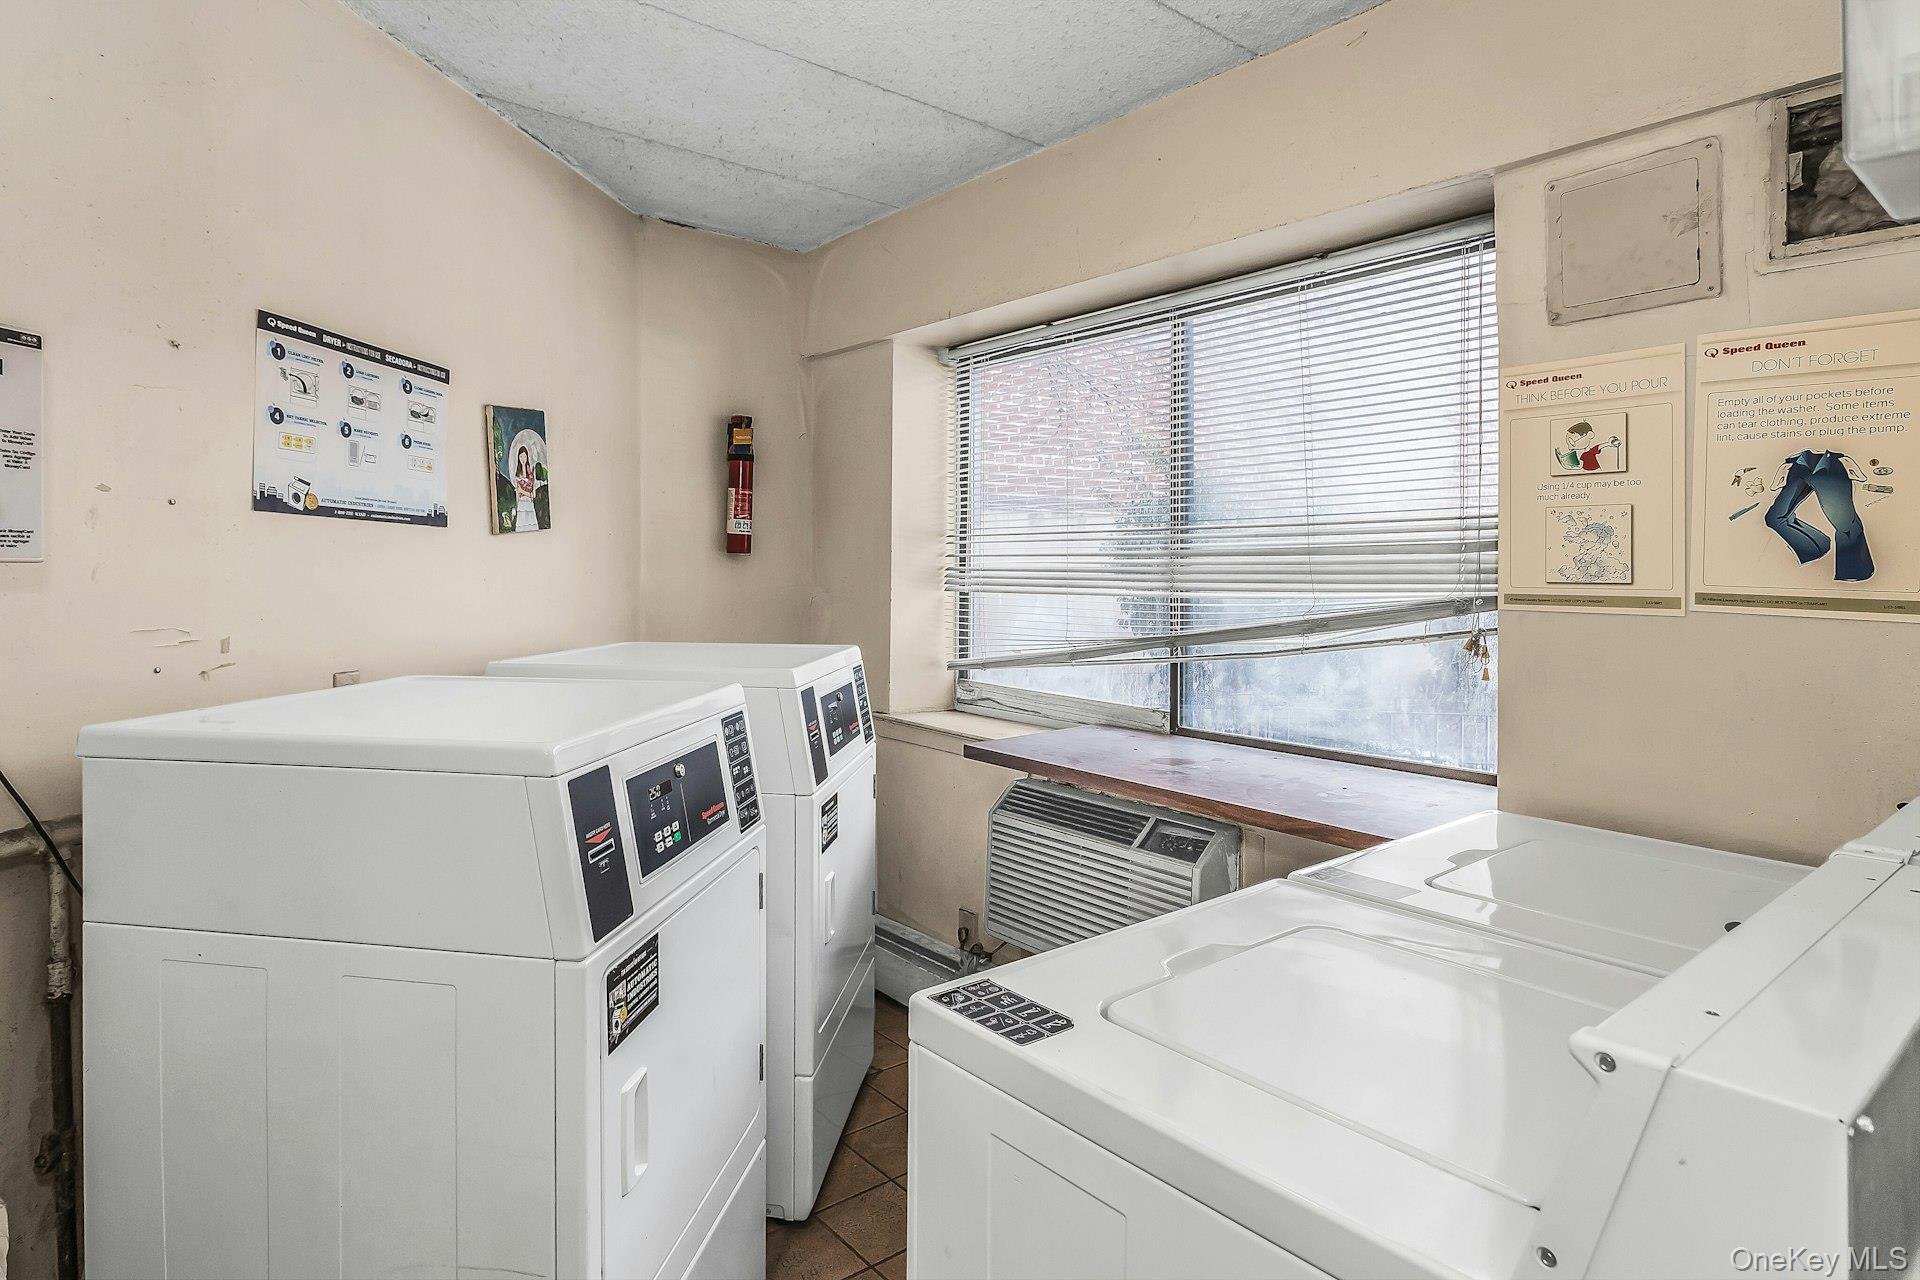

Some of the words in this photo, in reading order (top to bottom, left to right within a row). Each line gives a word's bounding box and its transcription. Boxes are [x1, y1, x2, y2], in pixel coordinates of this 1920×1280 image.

[277, 320, 297, 332] Speed
[298, 327, 317, 338] Queen
[322, 334, 341, 347] DRYER
[385, 354, 413, 369] SECADORA
[1722, 343, 1761, 355] Speed
[1765, 339, 1806, 350] Queen
[1751, 356, 1803, 373] DON'T
[1809, 348, 1879, 366] FORGET
[1515, 391, 1547, 404] THINK
[1550, 386, 1596, 401] BEFORE
[1599, 382, 1627, 394] YOU
[1631, 376, 1668, 391] POUR
[1519, 377, 1549, 388] Speed
[1551, 373, 1582, 383] Queen
[1717, 397, 1750, 407] Empty
[1752, 395, 1764, 404] all
[1766, 394, 1777, 404] of
[1779, 394, 1803, 404] your
[1806, 390, 1852, 401] pockets
[1855, 386, 1894, 397] before
[1717, 409, 1755, 418] loading
[1758, 407, 1775, 416] the
[1777, 404, 1820, 414] washer.
[1825, 402, 1859, 411] Some
[1862, 399, 1895, 409] items
[1717, 422, 1735, 430] can
[1810, 414, 1859, 425] produce
[1861, 411, 1911, 421] extreme
[1716, 433, 1734, 442] lint,
[1736, 432, 1768, 441] cause
[1770, 430, 1802, 439] stains
[1805, 429, 1816, 437] or
[1819, 428, 1844, 437] plug
[1847, 425, 1866, 434] the
[1869, 424, 1908, 435] pump.
[1537, 483, 1560, 491] Using
[1562, 481, 1575, 489] 1/4
[1593, 480, 1612, 488] may
[1613, 479, 1625, 487] be
[321, 498, 346, 506] AUTOMATIC
[1536, 493, 1559, 501] much
[1560, 492, 1592, 500] already.
[627, 958, 658, 992] AUTOMATIC
[627, 968, 658, 1003] INDUSTRIES
